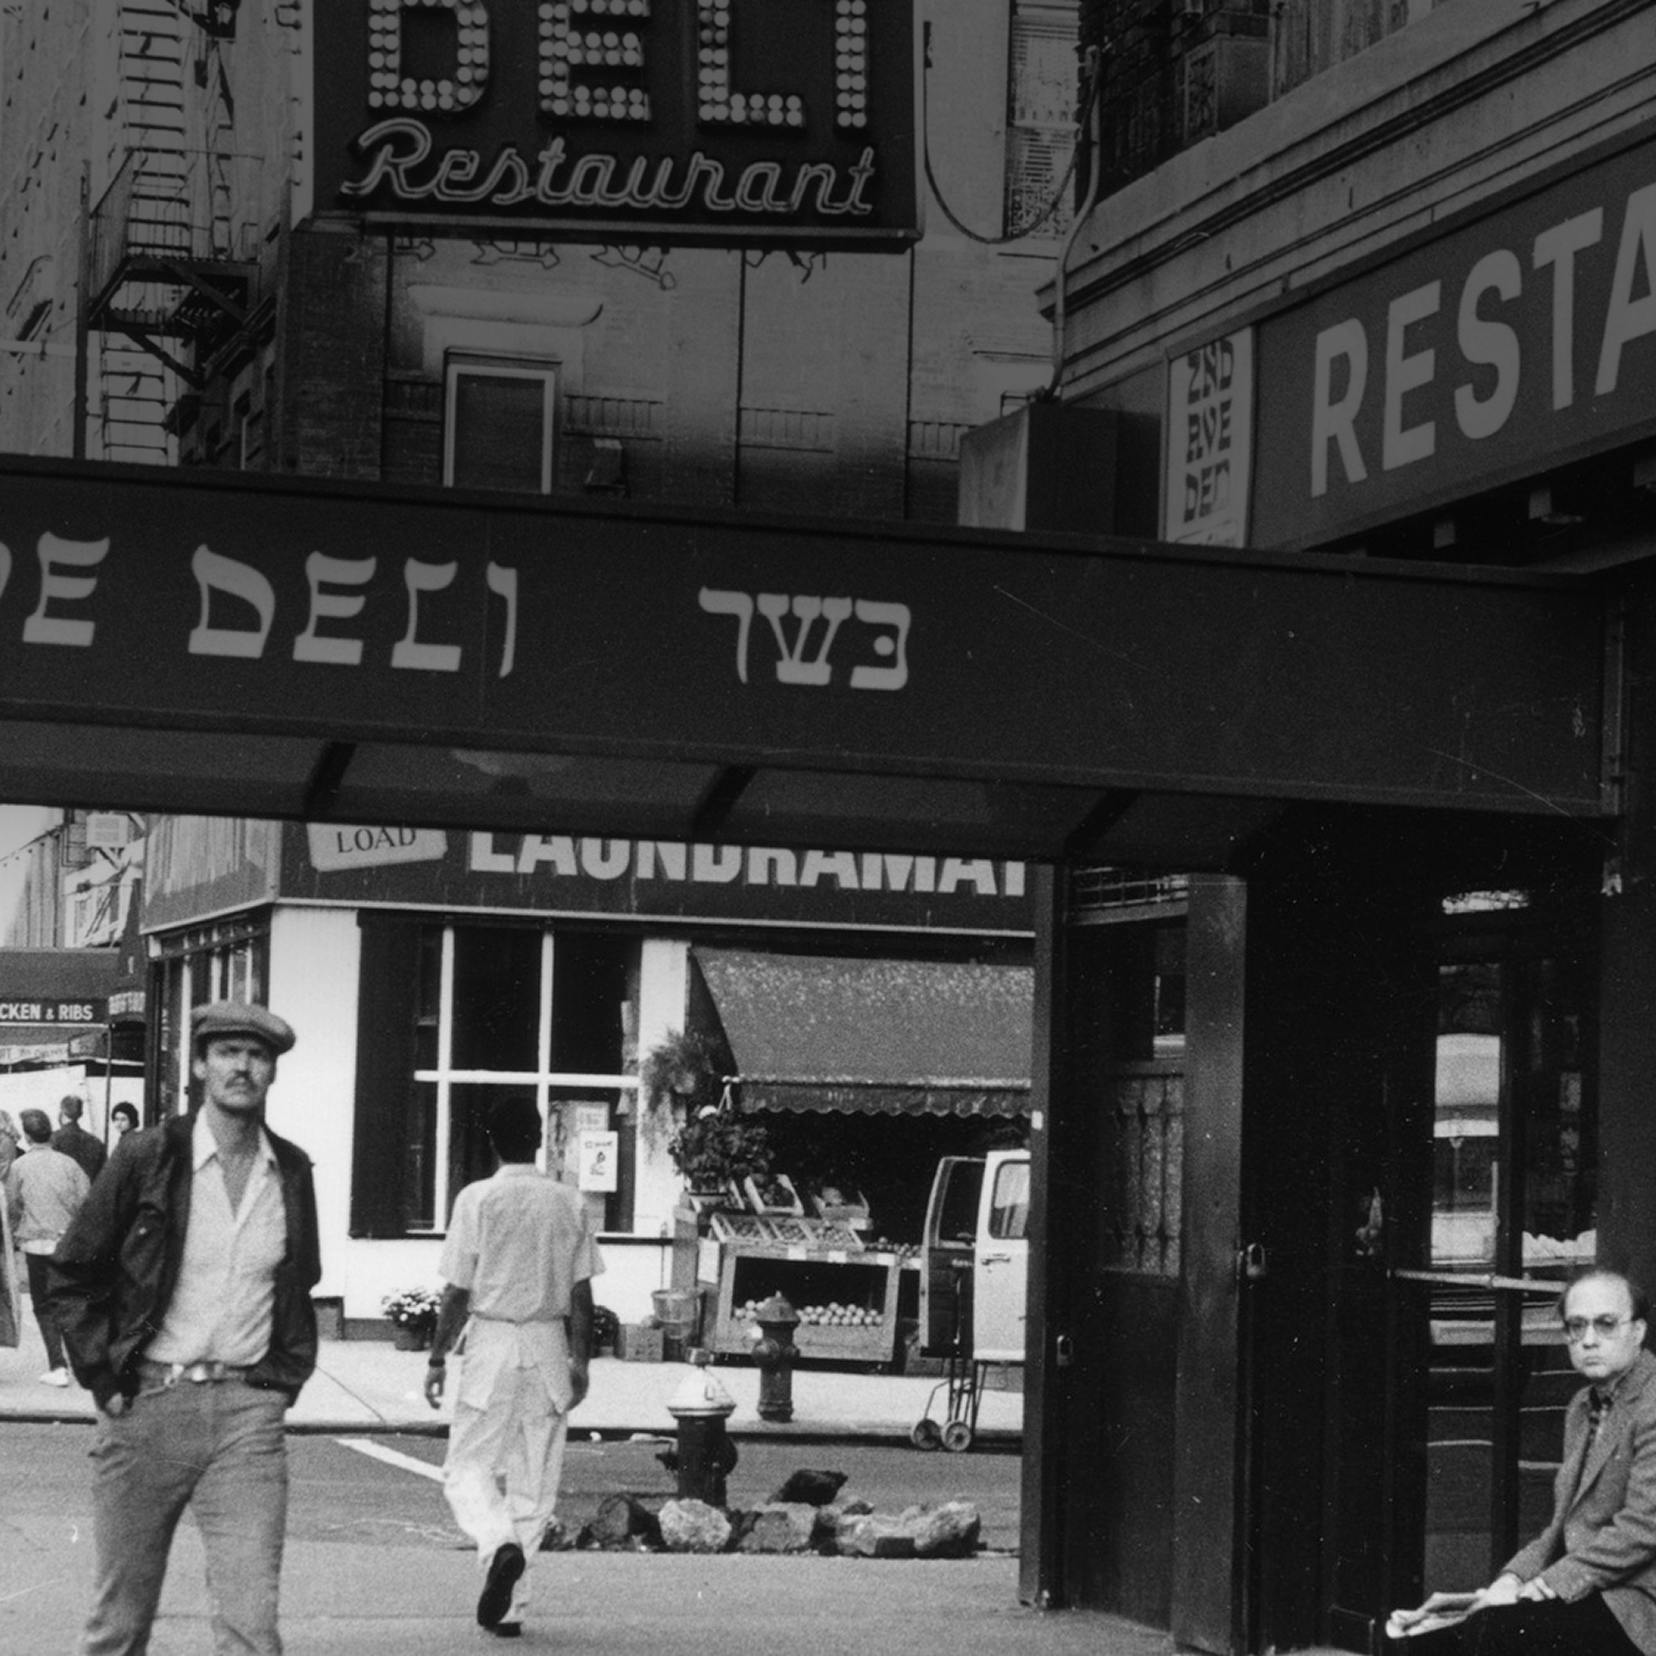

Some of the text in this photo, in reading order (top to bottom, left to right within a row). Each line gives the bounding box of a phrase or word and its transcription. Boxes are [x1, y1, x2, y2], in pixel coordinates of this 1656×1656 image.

[368, 0, 869, 127] DELI
[340, 117, 875, 215] Restaurant
[1187, 338, 1234, 404] 2ND
[1312, 183, 1656, 498] RESTA
[1186, 399, 1233, 464] AVE
[0, 531, 518, 679] E DELI
[336, 826, 418, 854] LOAD
[45, 1008, 55, 1020] &
[58, 1004, 93, 1020] RIBS
